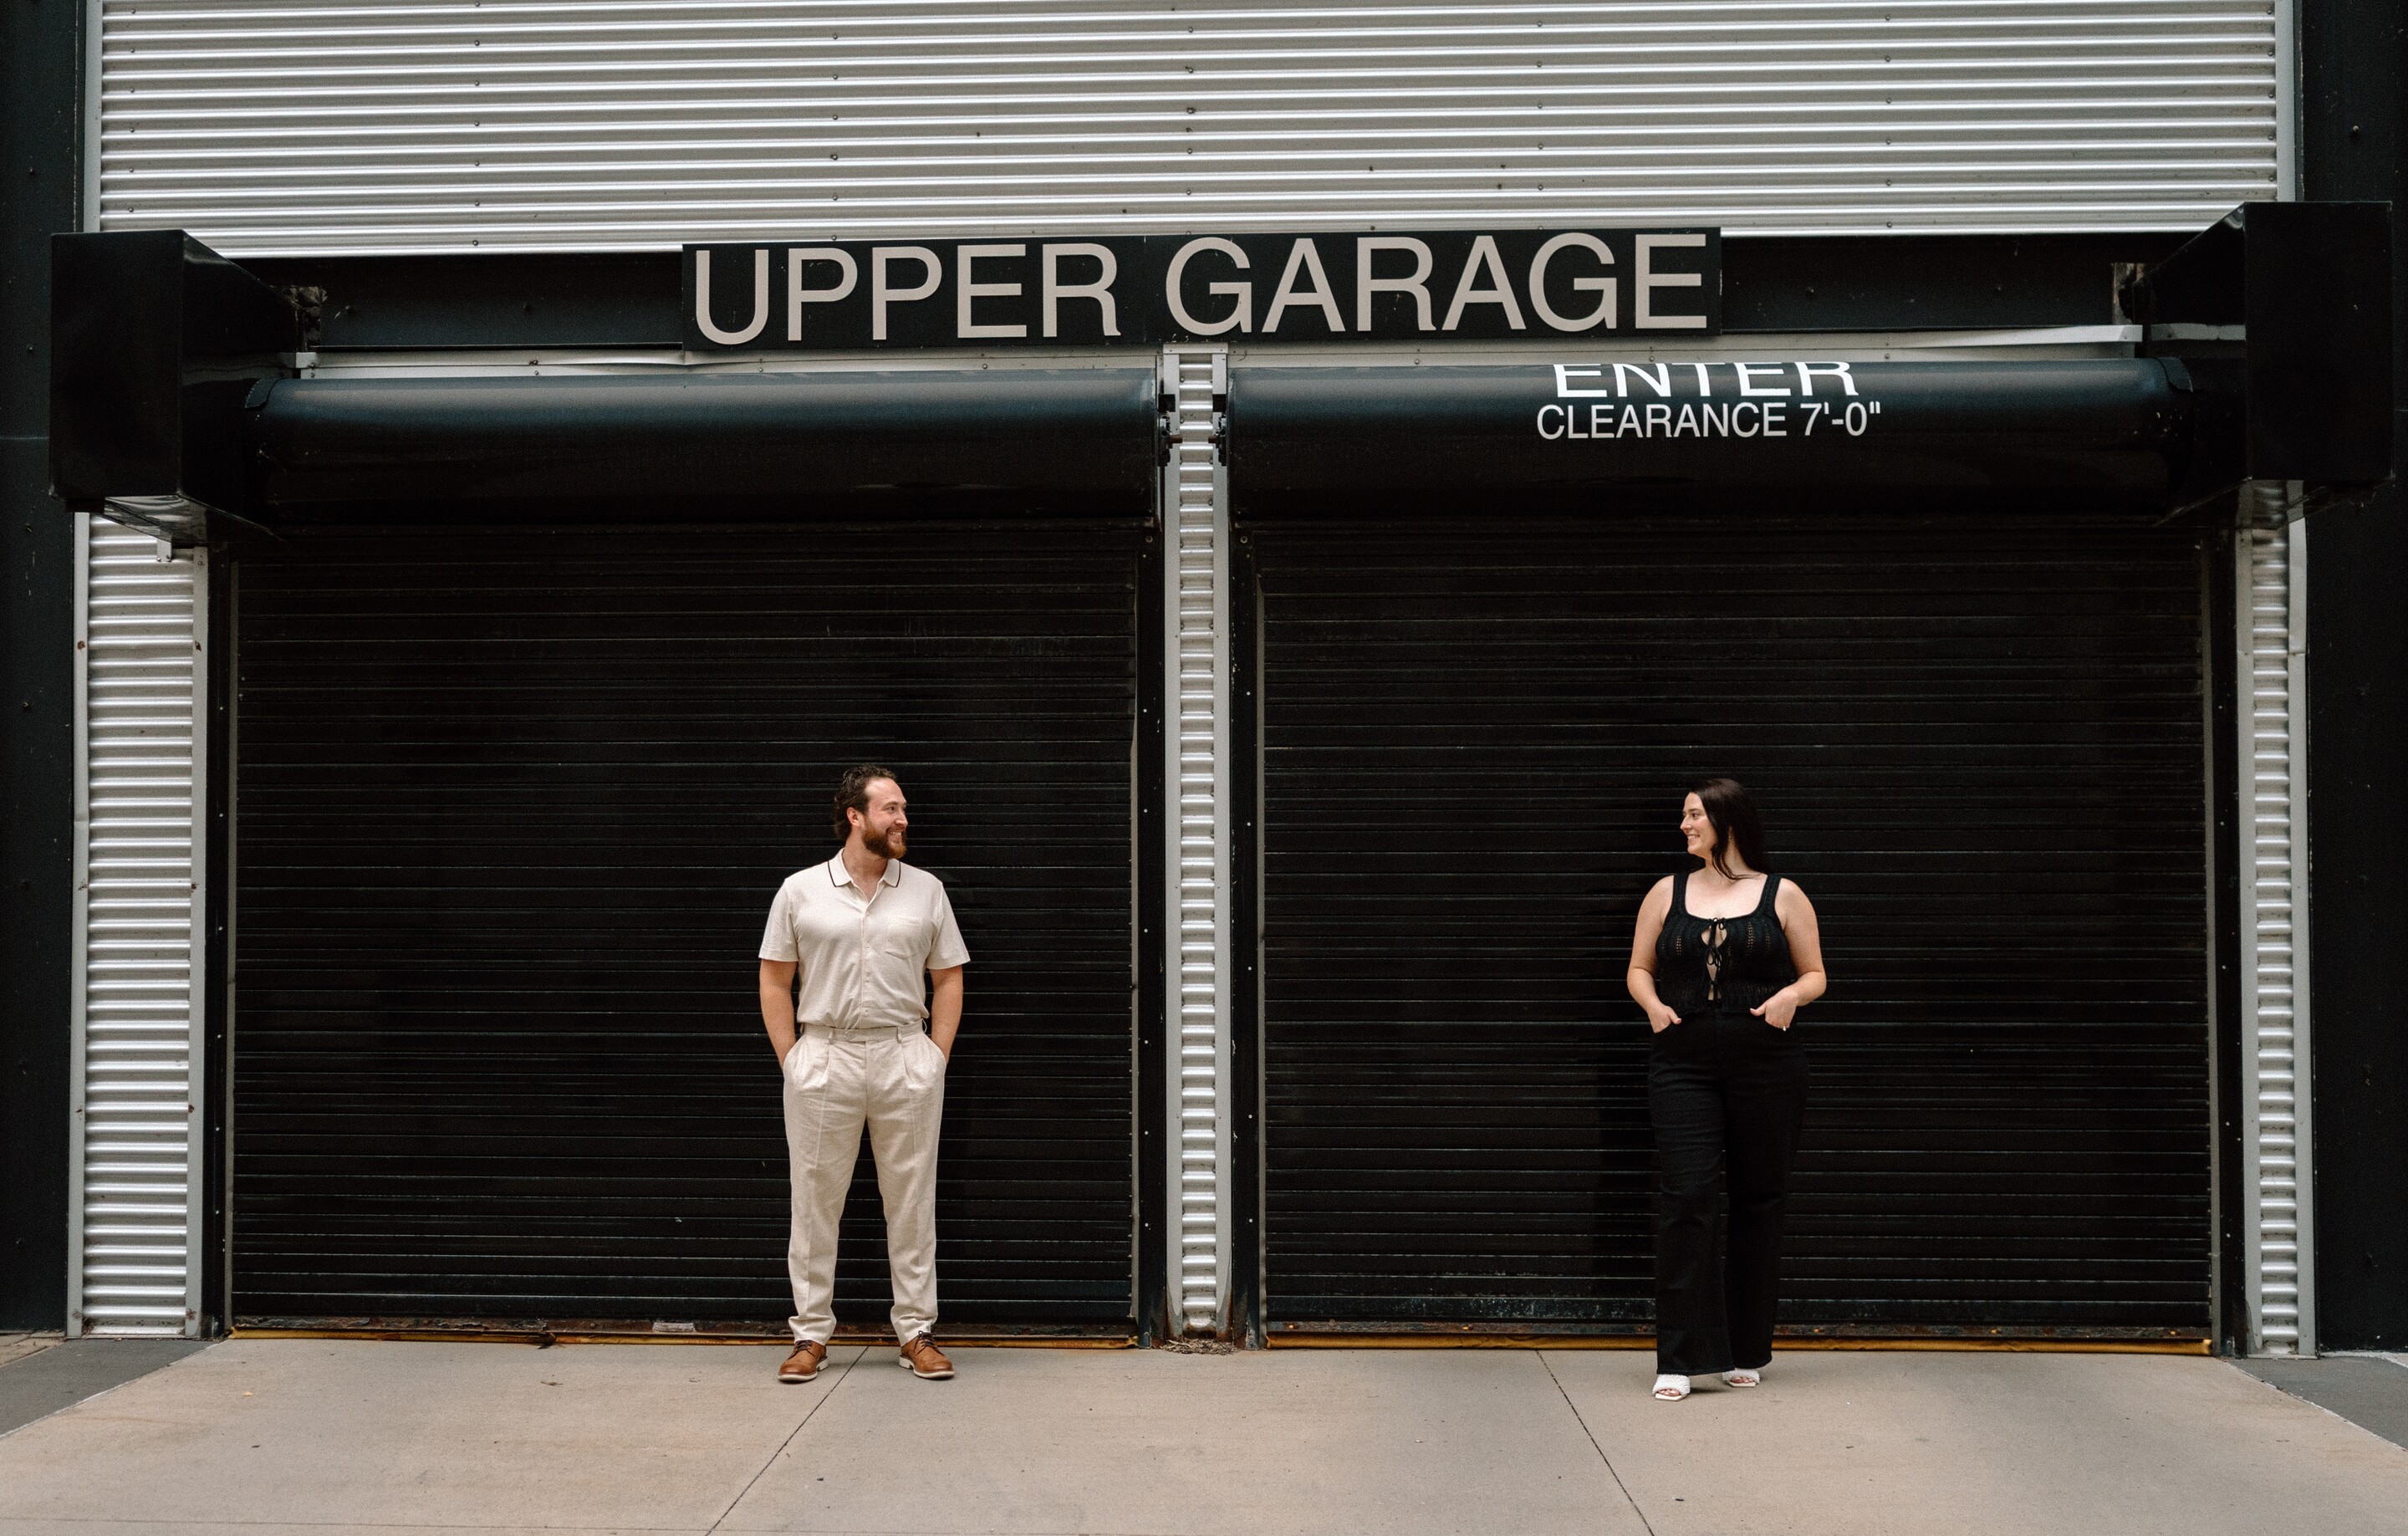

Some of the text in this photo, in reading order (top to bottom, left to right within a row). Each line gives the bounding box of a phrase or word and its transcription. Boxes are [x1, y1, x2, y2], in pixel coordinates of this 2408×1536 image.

[696, 232, 1707, 344] UPPER GARAGE
[1553, 361, 1859, 397] ENTER
[1537, 401, 1881, 440] CLEARANCE 7'-0"
